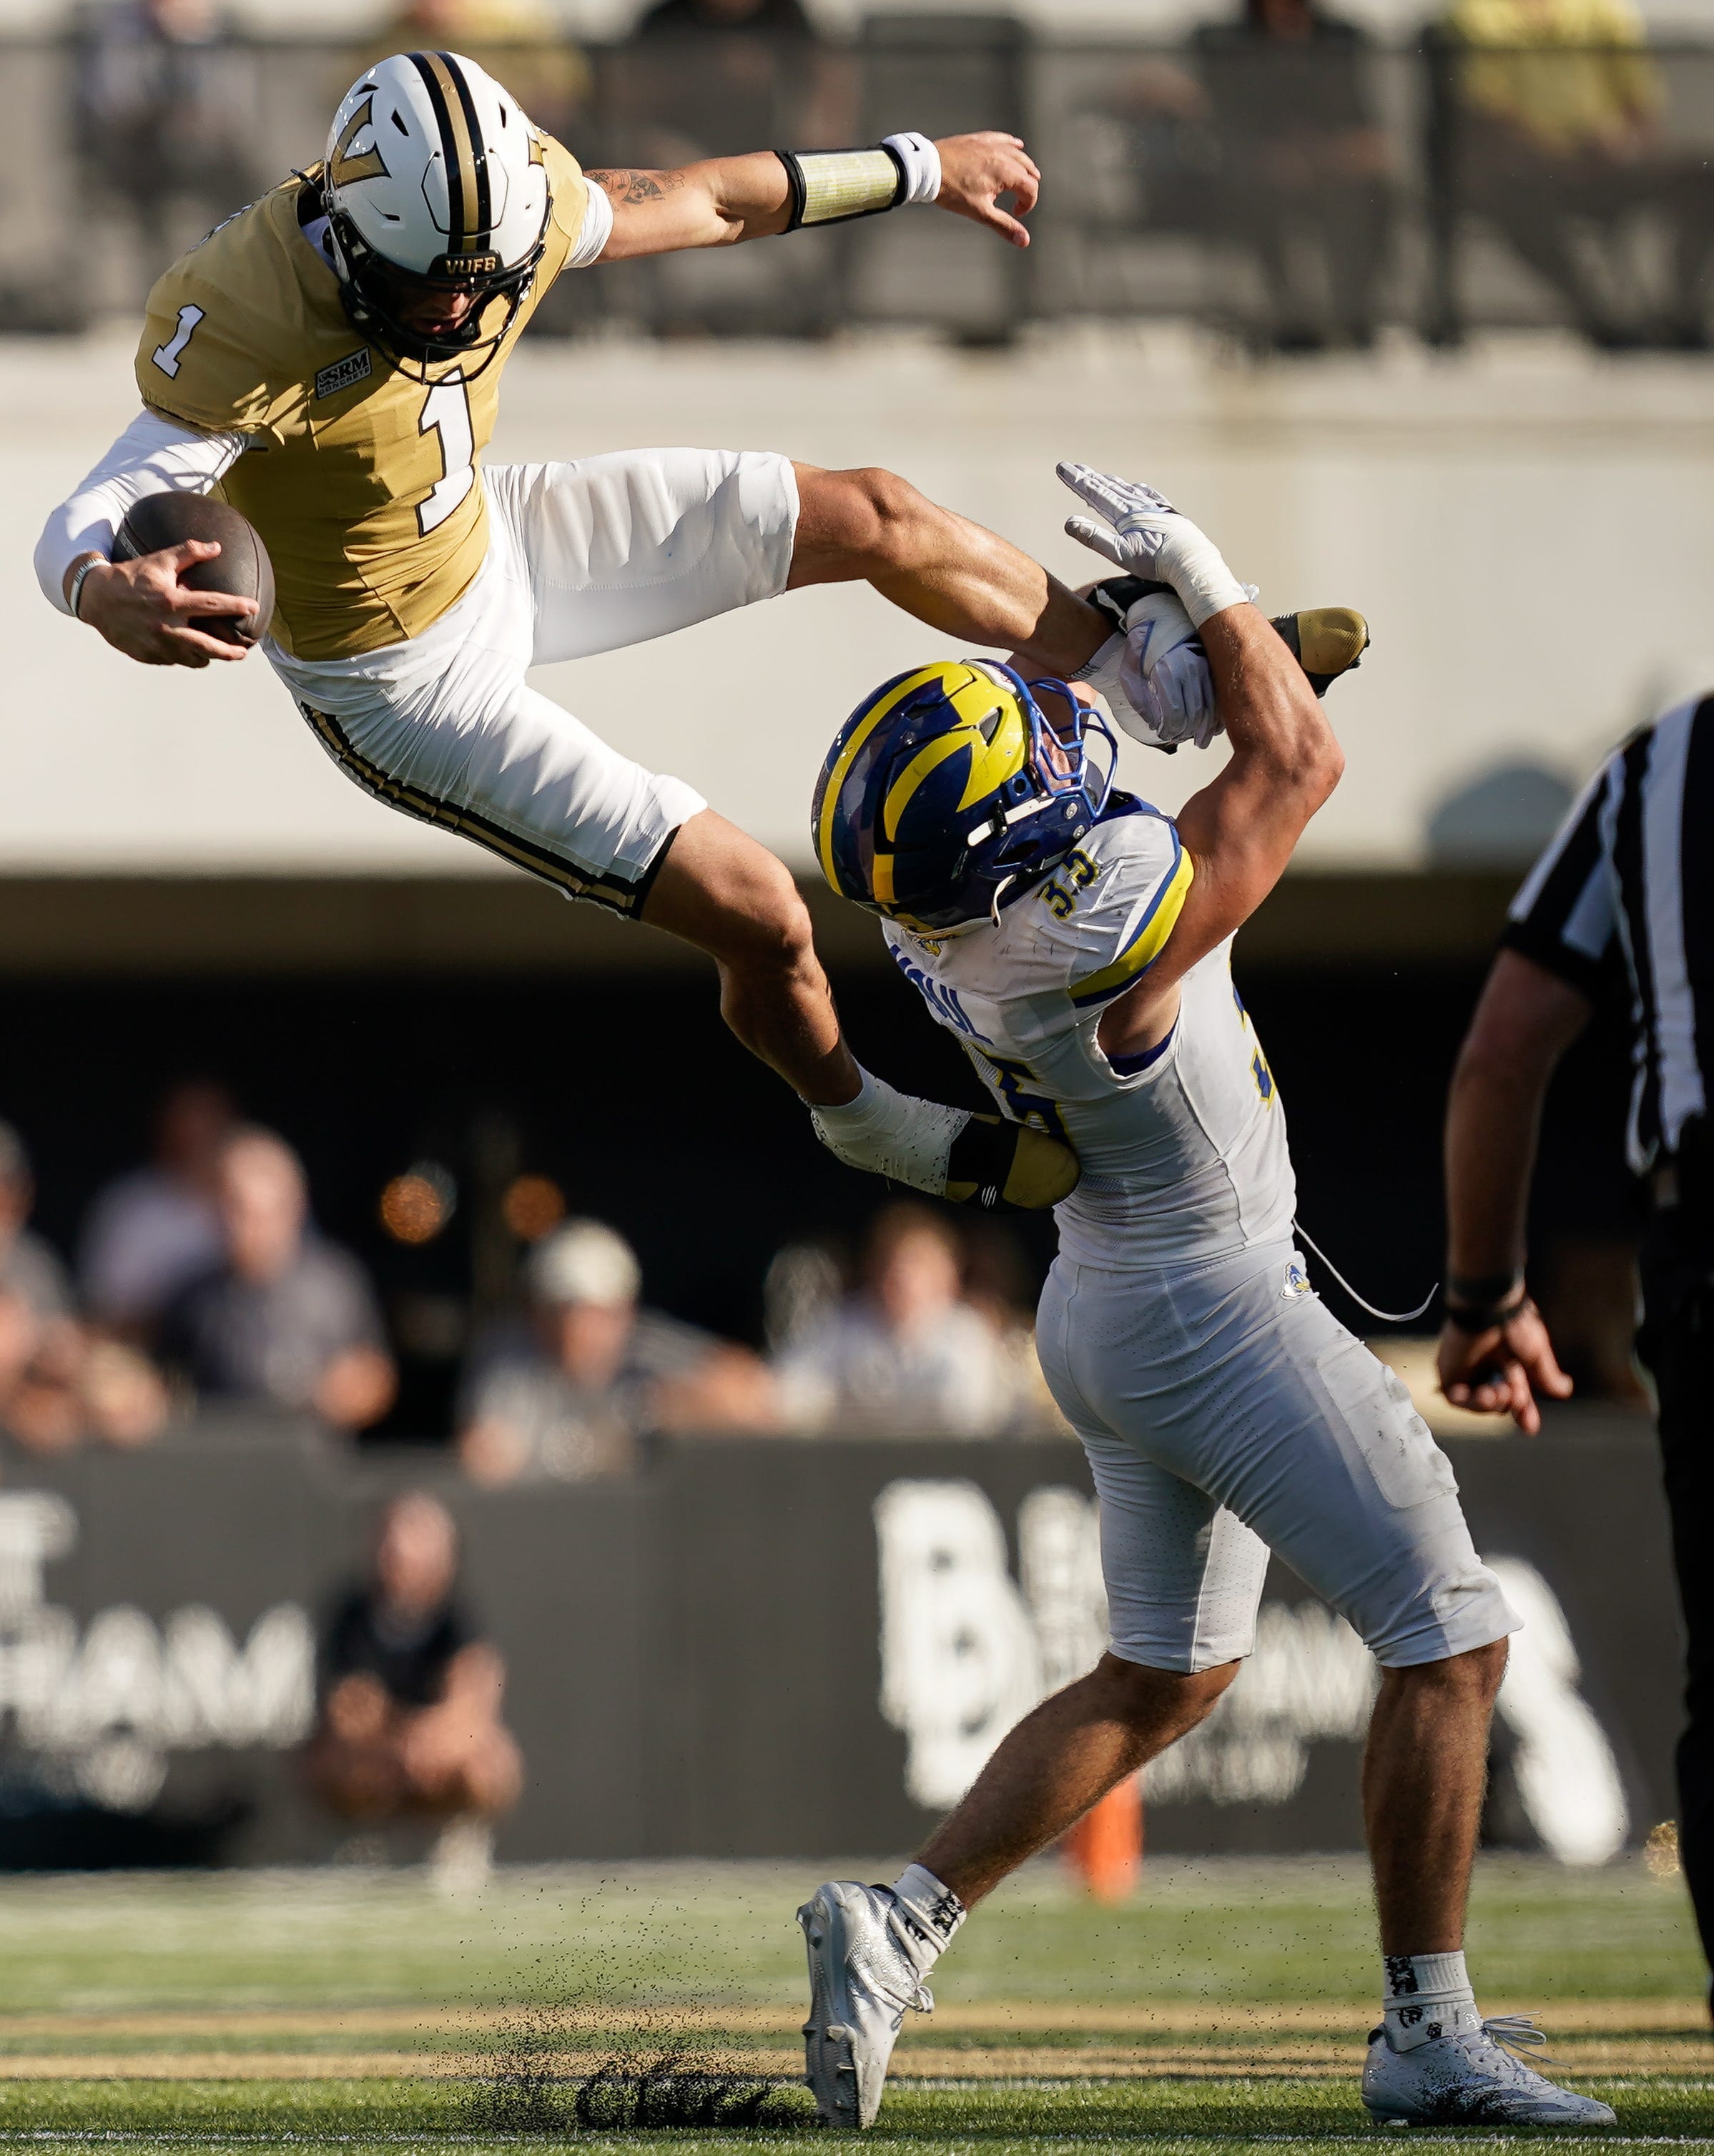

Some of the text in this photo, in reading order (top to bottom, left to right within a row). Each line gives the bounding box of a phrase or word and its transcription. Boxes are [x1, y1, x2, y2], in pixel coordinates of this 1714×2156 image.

[445, 257, 496, 275] VUFB
[151, 303, 206, 380] 1
[327, 351, 370, 384] SRM
[415, 363, 476, 538] 1
[1038, 848, 1100, 920] 35
